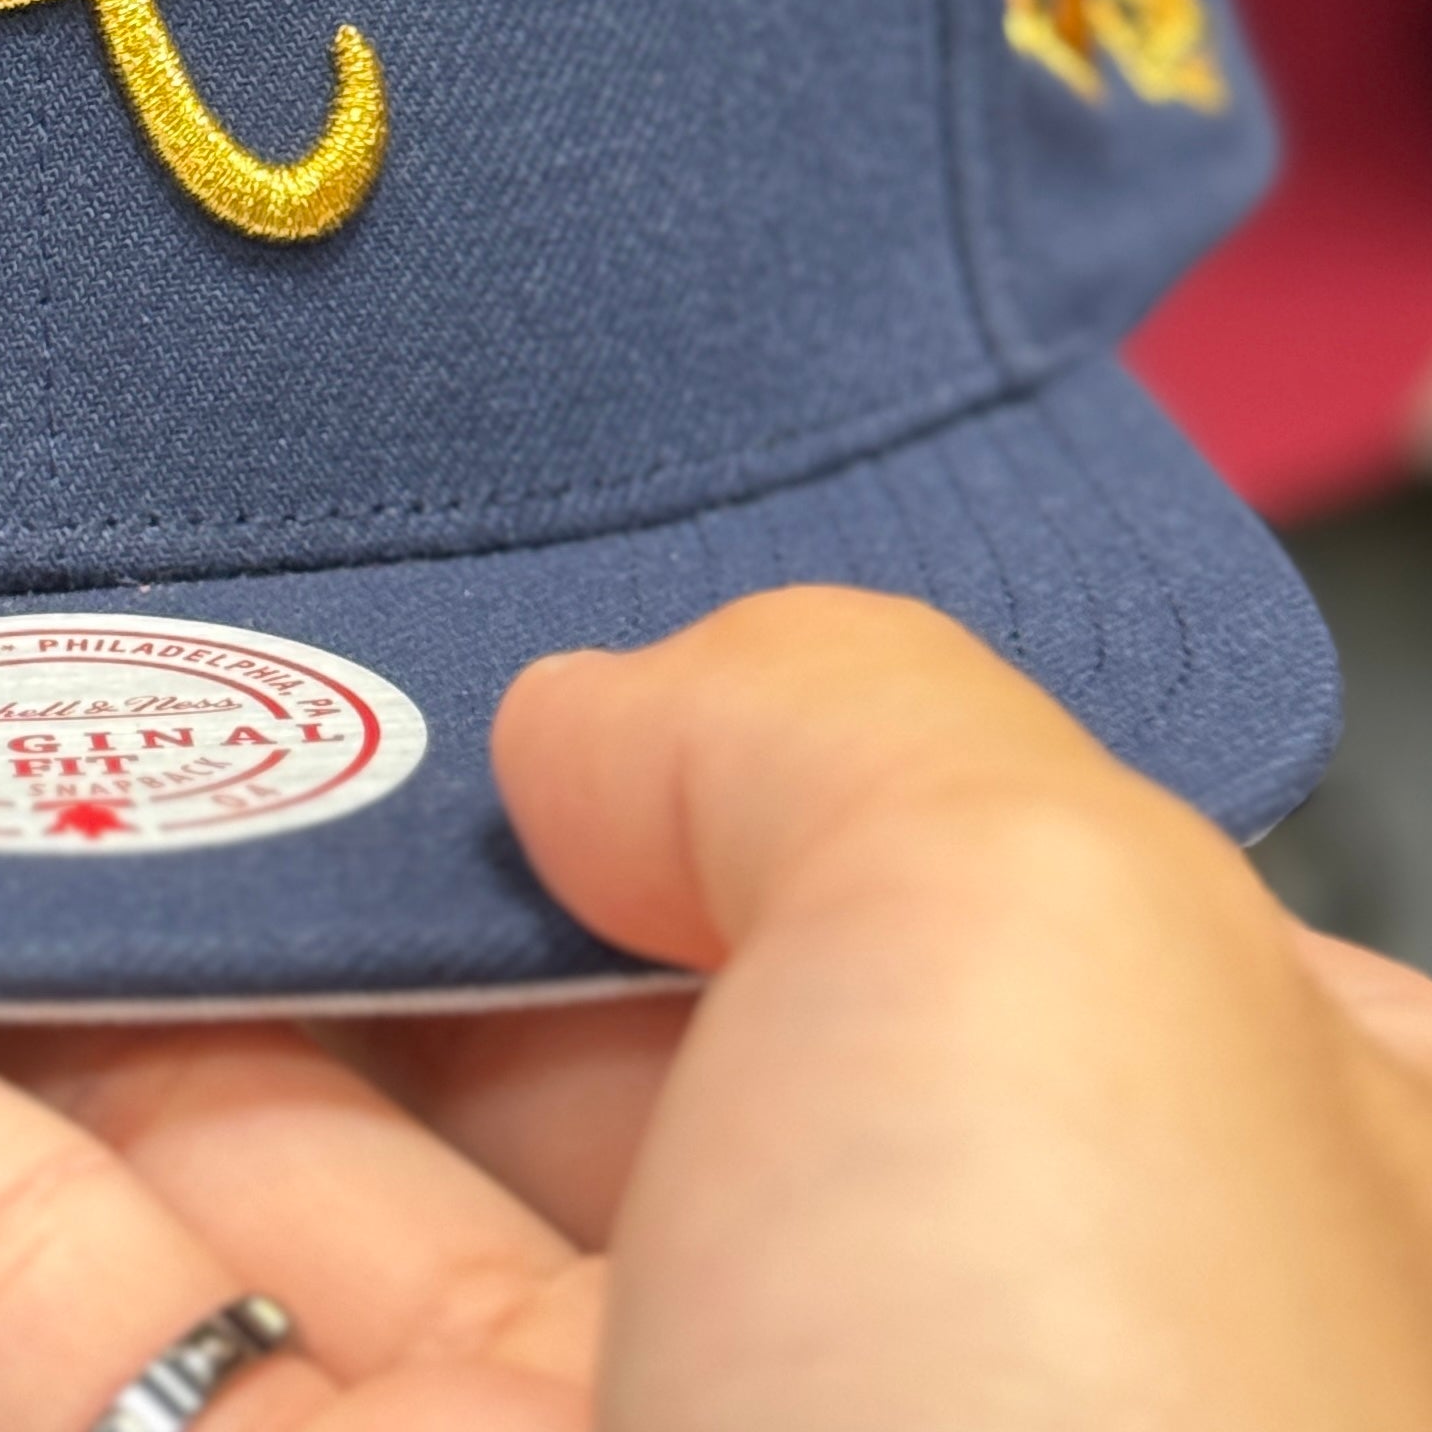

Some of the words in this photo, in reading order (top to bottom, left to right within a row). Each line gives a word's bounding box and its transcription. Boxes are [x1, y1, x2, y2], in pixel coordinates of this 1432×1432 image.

[37, 638, 306, 696] PHILADELPHIA,
[296, 698, 342, 719] PA
[83, 700, 119, 715] &
[124, 694, 244, 715] Ness
[8, 754, 140, 779] FIT
[27, 755, 233, 797] SNAPBACK
